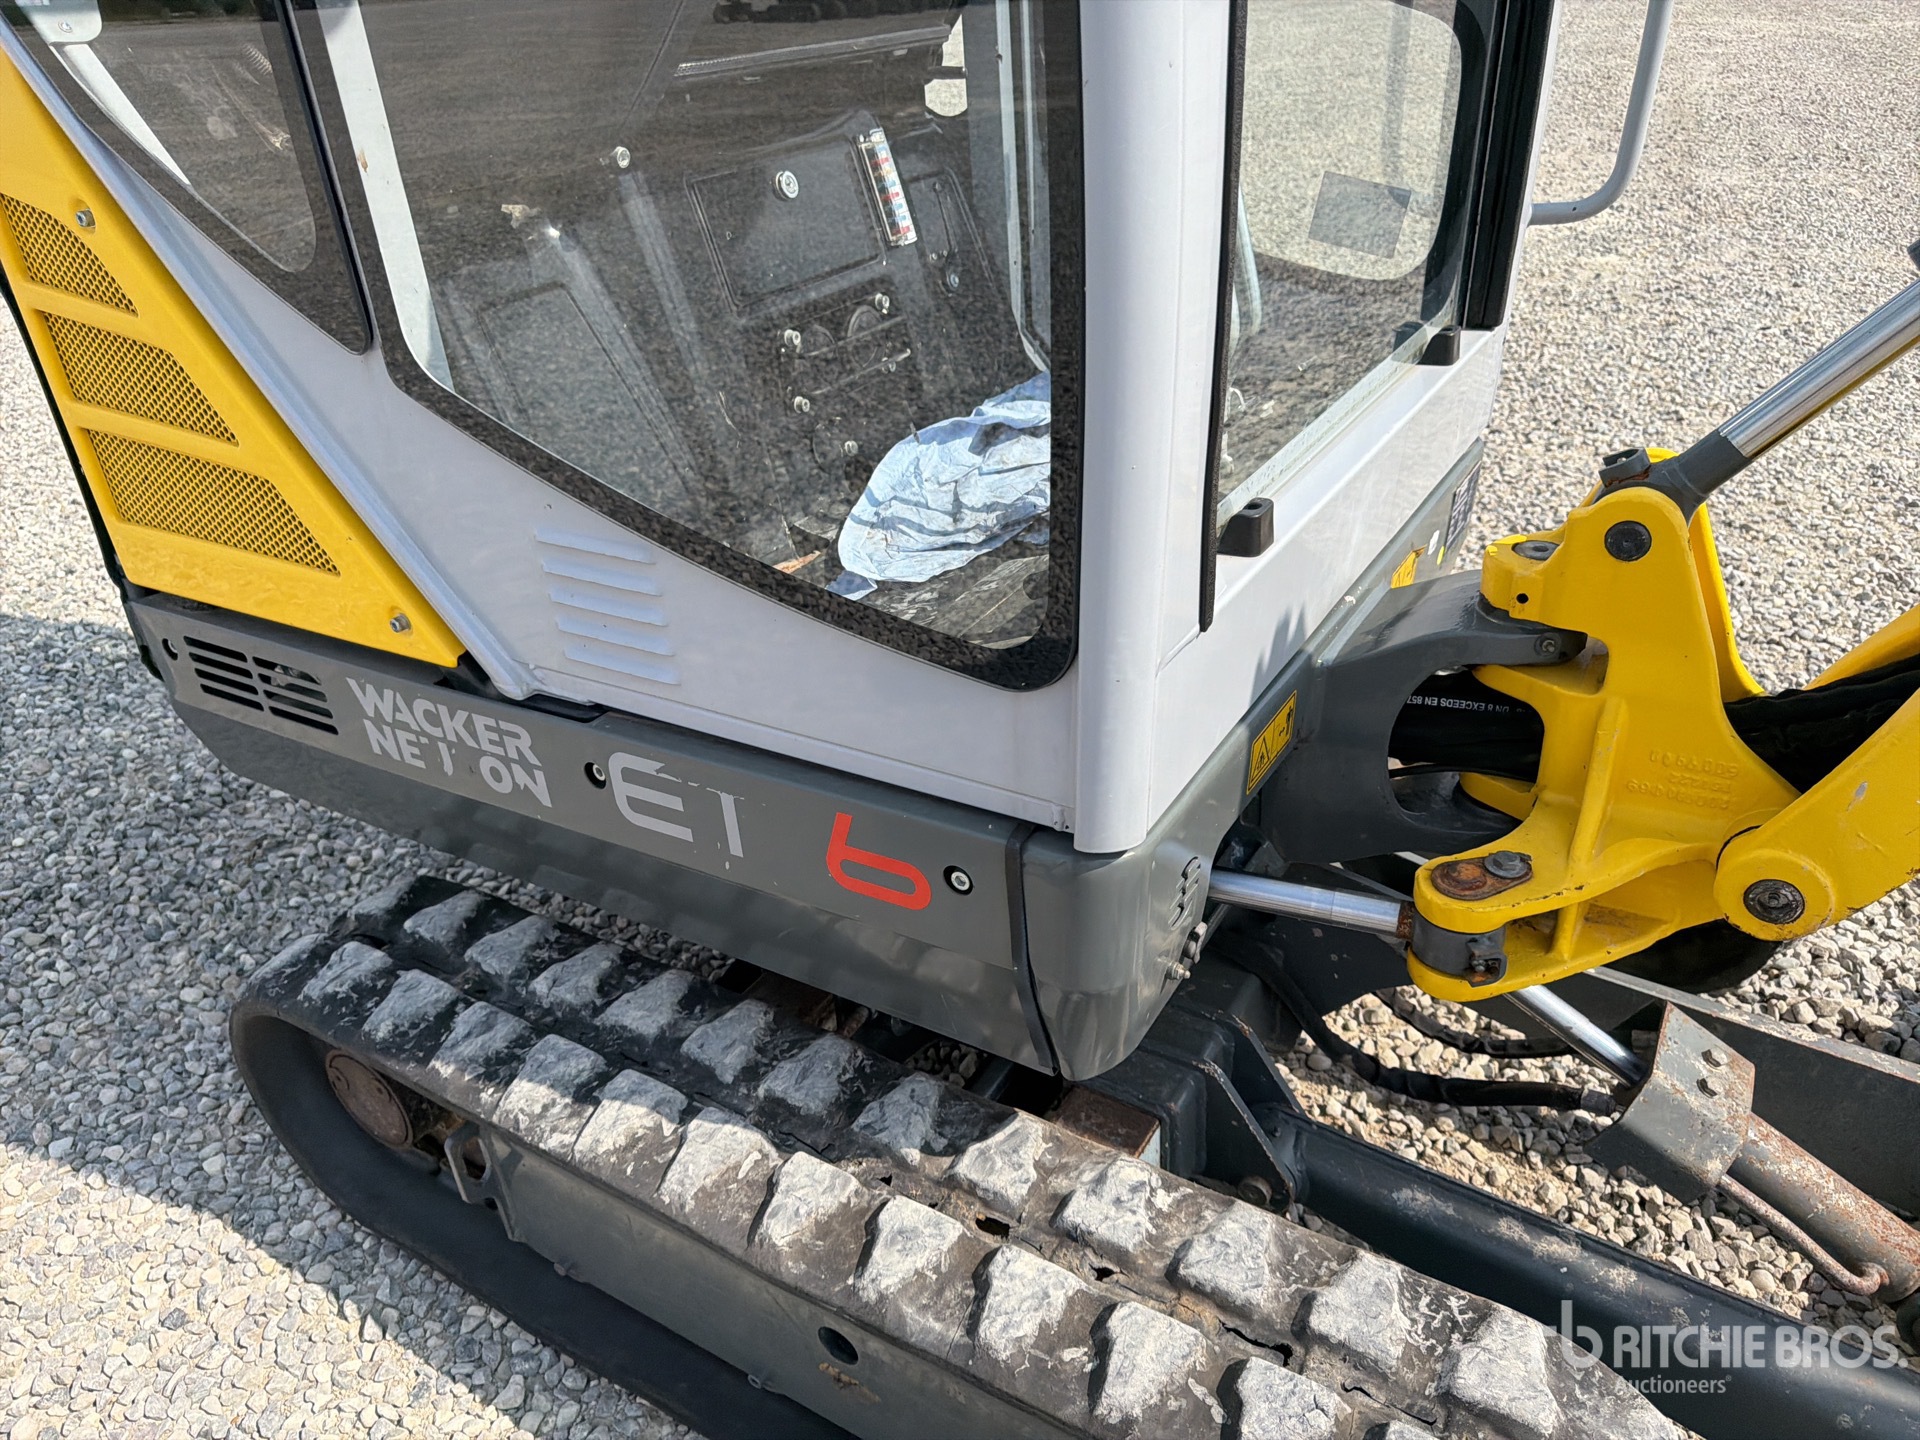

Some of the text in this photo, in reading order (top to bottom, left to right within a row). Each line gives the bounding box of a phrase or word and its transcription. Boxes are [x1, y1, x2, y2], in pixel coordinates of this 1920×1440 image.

[1424, 696, 1438, 707] EN
[1440, 697, 1486, 712] EXCEEDS
[346, 677, 542, 767] WACKER
